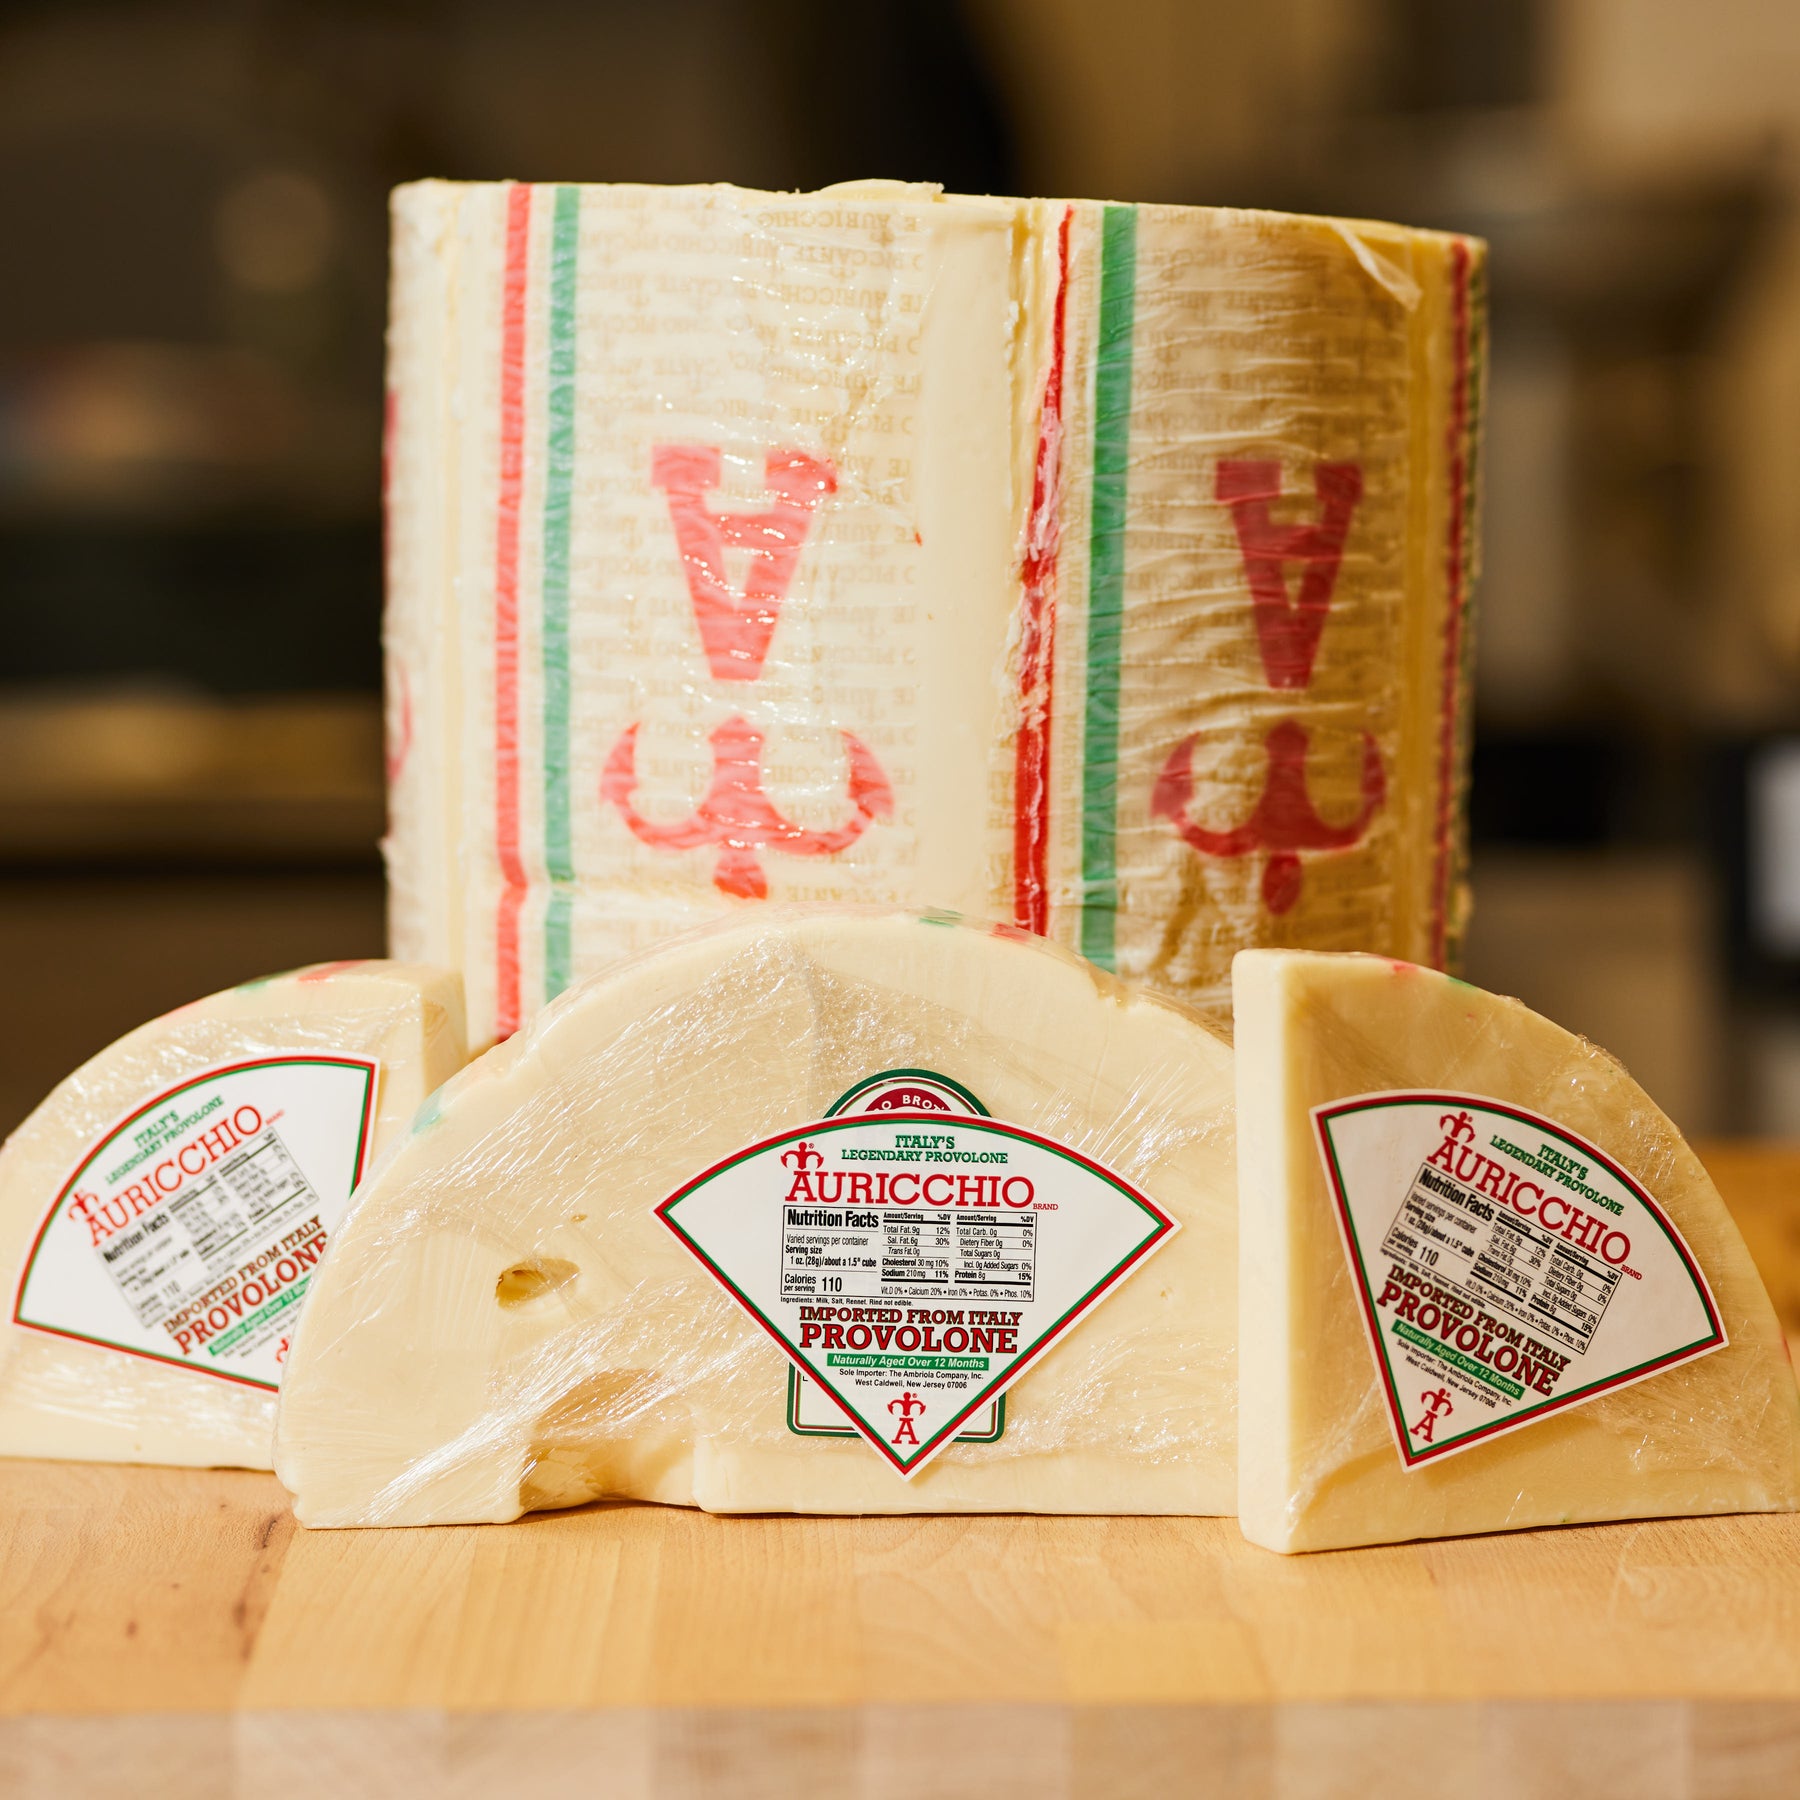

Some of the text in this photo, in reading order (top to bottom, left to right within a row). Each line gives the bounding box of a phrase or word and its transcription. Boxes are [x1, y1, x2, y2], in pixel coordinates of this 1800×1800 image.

[652, 446, 838, 680] A
[1215, 460, 1363, 689] A
[895, 1135, 954, 1149] ITALY'S
[842, 1149, 1008, 1164] LEGENDARY PROVOLONE
[1537, 1144, 1588, 1181] ITALY'S
[86, 1105, 262, 1248] AURICCHIO
[1489, 1135, 1624, 1217] LEGENDARY PROVOLONE
[785, 1171, 1034, 1208] AURICCHIO
[1419, 1168, 1497, 1223] Nutrition Facts
[1033, 1203, 1058, 1211] BRAND
[1426, 1135, 1631, 1264] AURICCHIO
[788, 1209, 879, 1228] Nutrition Facts
[883, 1225, 898, 1233] Total
[936, 1227, 950, 1235] 12%
[956, 1227, 971, 1235] Total
[972, 1228, 988, 1236] Carb.
[1022, 1229, 1033, 1237] 0%
[787, 1234, 869, 1247] Varied servings per container
[936, 1238, 949, 1246] 30%
[981, 1239, 994, 1247] Fiber
[996, 1239, 1003, 1249] 0g
[1022, 1240, 1032, 1248] 0%
[785, 1245, 823, 1255] Serving size
[974, 1250, 992, 1259] Sugars
[1418, 1245, 1441, 1268] 110
[862, 1258, 878, 1267] cube
[882, 1258, 916, 1266] Cholesterol
[925, 1261, 934, 1269] mg
[936, 1260, 949, 1268] 10%
[983, 1261, 999, 1269] Added
[1001, 1262, 1019, 1271] Sugars
[1021, 1263, 1032, 1271] 0%
[882, 1269, 905, 1277] Sodium
[935, 1271, 948, 1279] 11%
[955, 1271, 977, 1279] Protein
[1018, 1273, 1032, 1281] 15%
[1620, 1263, 1643, 1281] BRAND
[785, 1274, 843, 1292] Calories 110
[795, 1285, 815, 1293] serving
[1020, 1290, 1032, 1298] 10%
[161, 1274, 240, 1335] IMPORTED
[800, 1306, 1023, 1326] IMPORTED FROM ITALY
[1388, 1263, 1475, 1321] IMPORTED
[1473, 1310, 1524, 1348] FROM
[1523, 1336, 1571, 1373] ITALY
[800, 1323, 1018, 1353] PROVOLONE
[1377, 1279, 1560, 1397] PROVOLONE
[833, 1355, 985, 1368] Naturally Aged Over 12 Months
[1395, 1323, 1521, 1397] Naturally Aged Over 12 Months
[1437, 1360, 1449, 1373] The
[857, 1370, 888, 1379] Importer:
[890, 1370, 902, 1378] The
[904, 1371, 934, 1379] Ambriola
[936, 1372, 970, 1382] Company,
[855, 1379, 870, 1387] West
[872, 1380, 905, 1389] Caldwell,
[923, 1382, 946, 1391] Jersey
[947, 1382, 967, 1390] 07006
[891, 1417, 920, 1445] A
[1409, 1405, 1444, 1443] A
